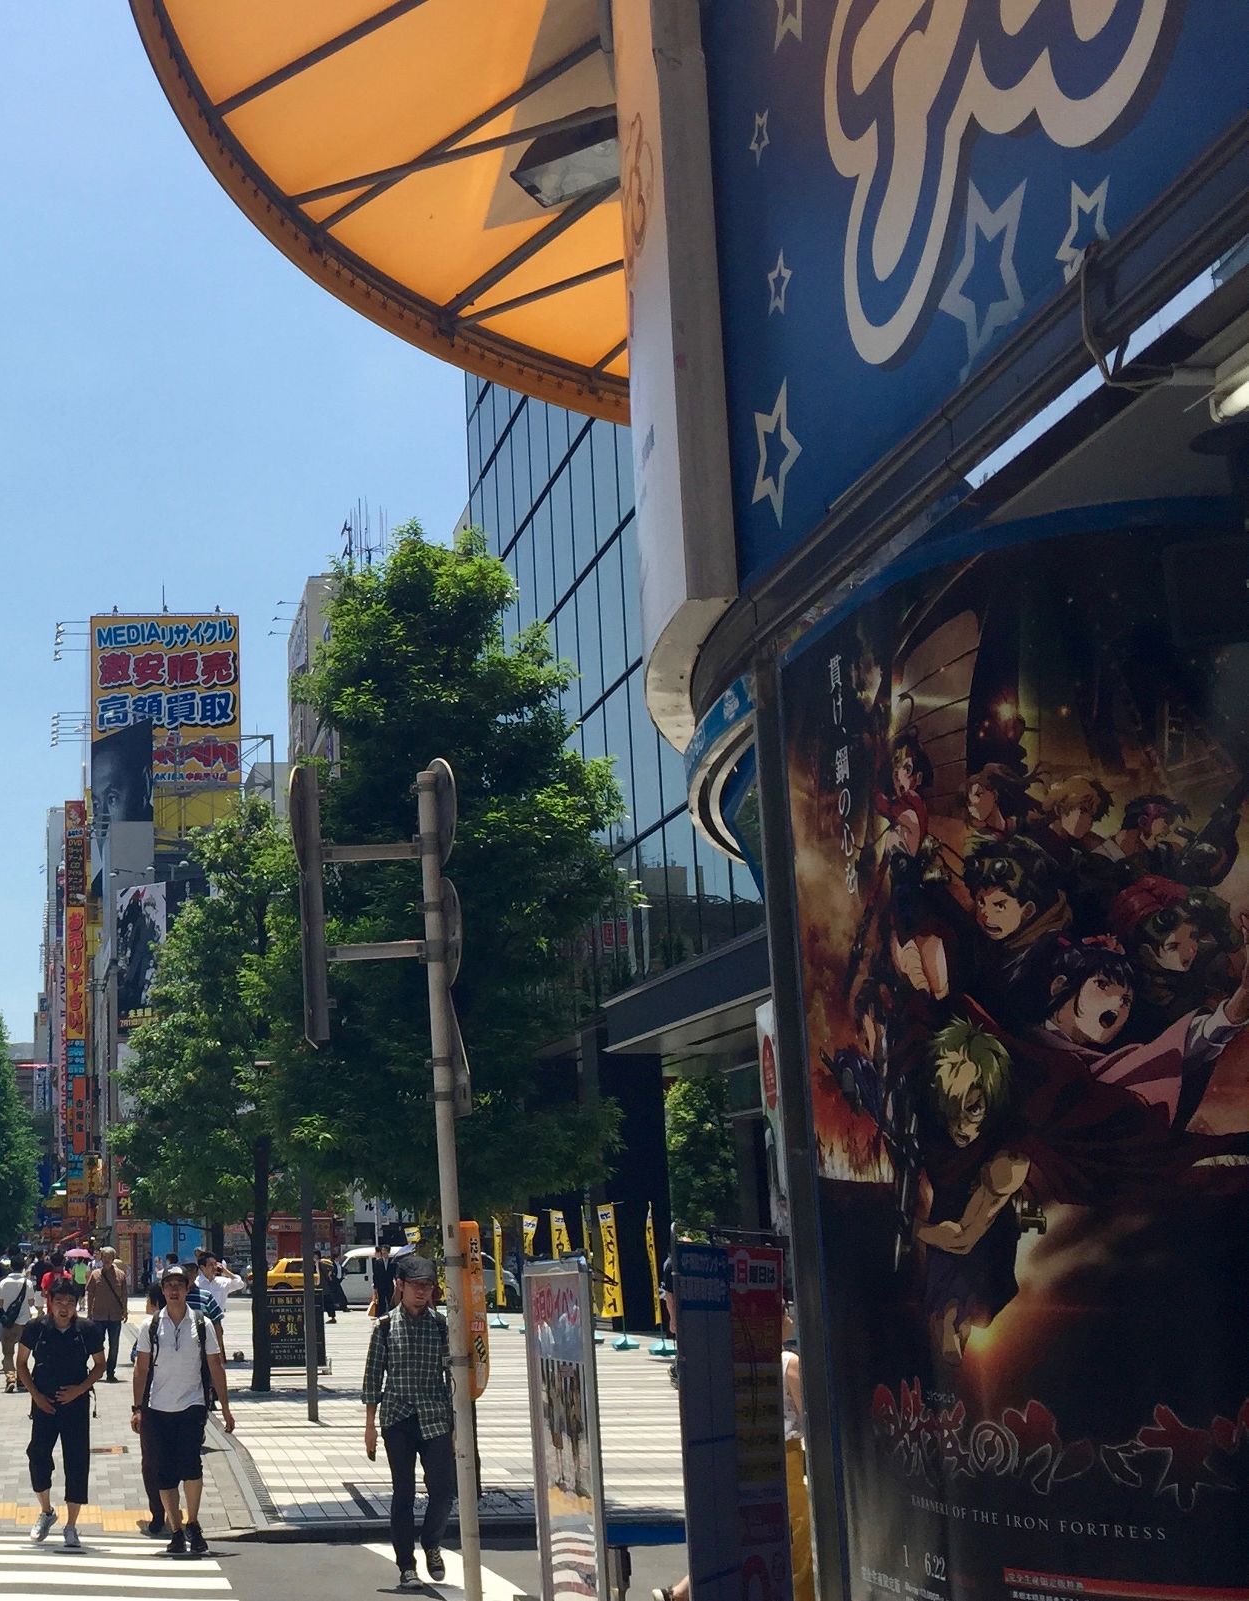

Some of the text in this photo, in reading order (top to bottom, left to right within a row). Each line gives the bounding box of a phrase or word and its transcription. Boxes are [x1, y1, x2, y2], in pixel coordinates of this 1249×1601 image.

[96, 620, 235, 650] MEDIAリサイクル
[98, 651, 236, 687] 激安販売
[97, 692, 235, 730] 高額買取
[952, 1505, 967, 1520] OF
[972, 1509, 998, 1526] THE
[1006, 1514, 1050, 1532] IRON
[1059, 1520, 1167, 1541] FORTRESS
